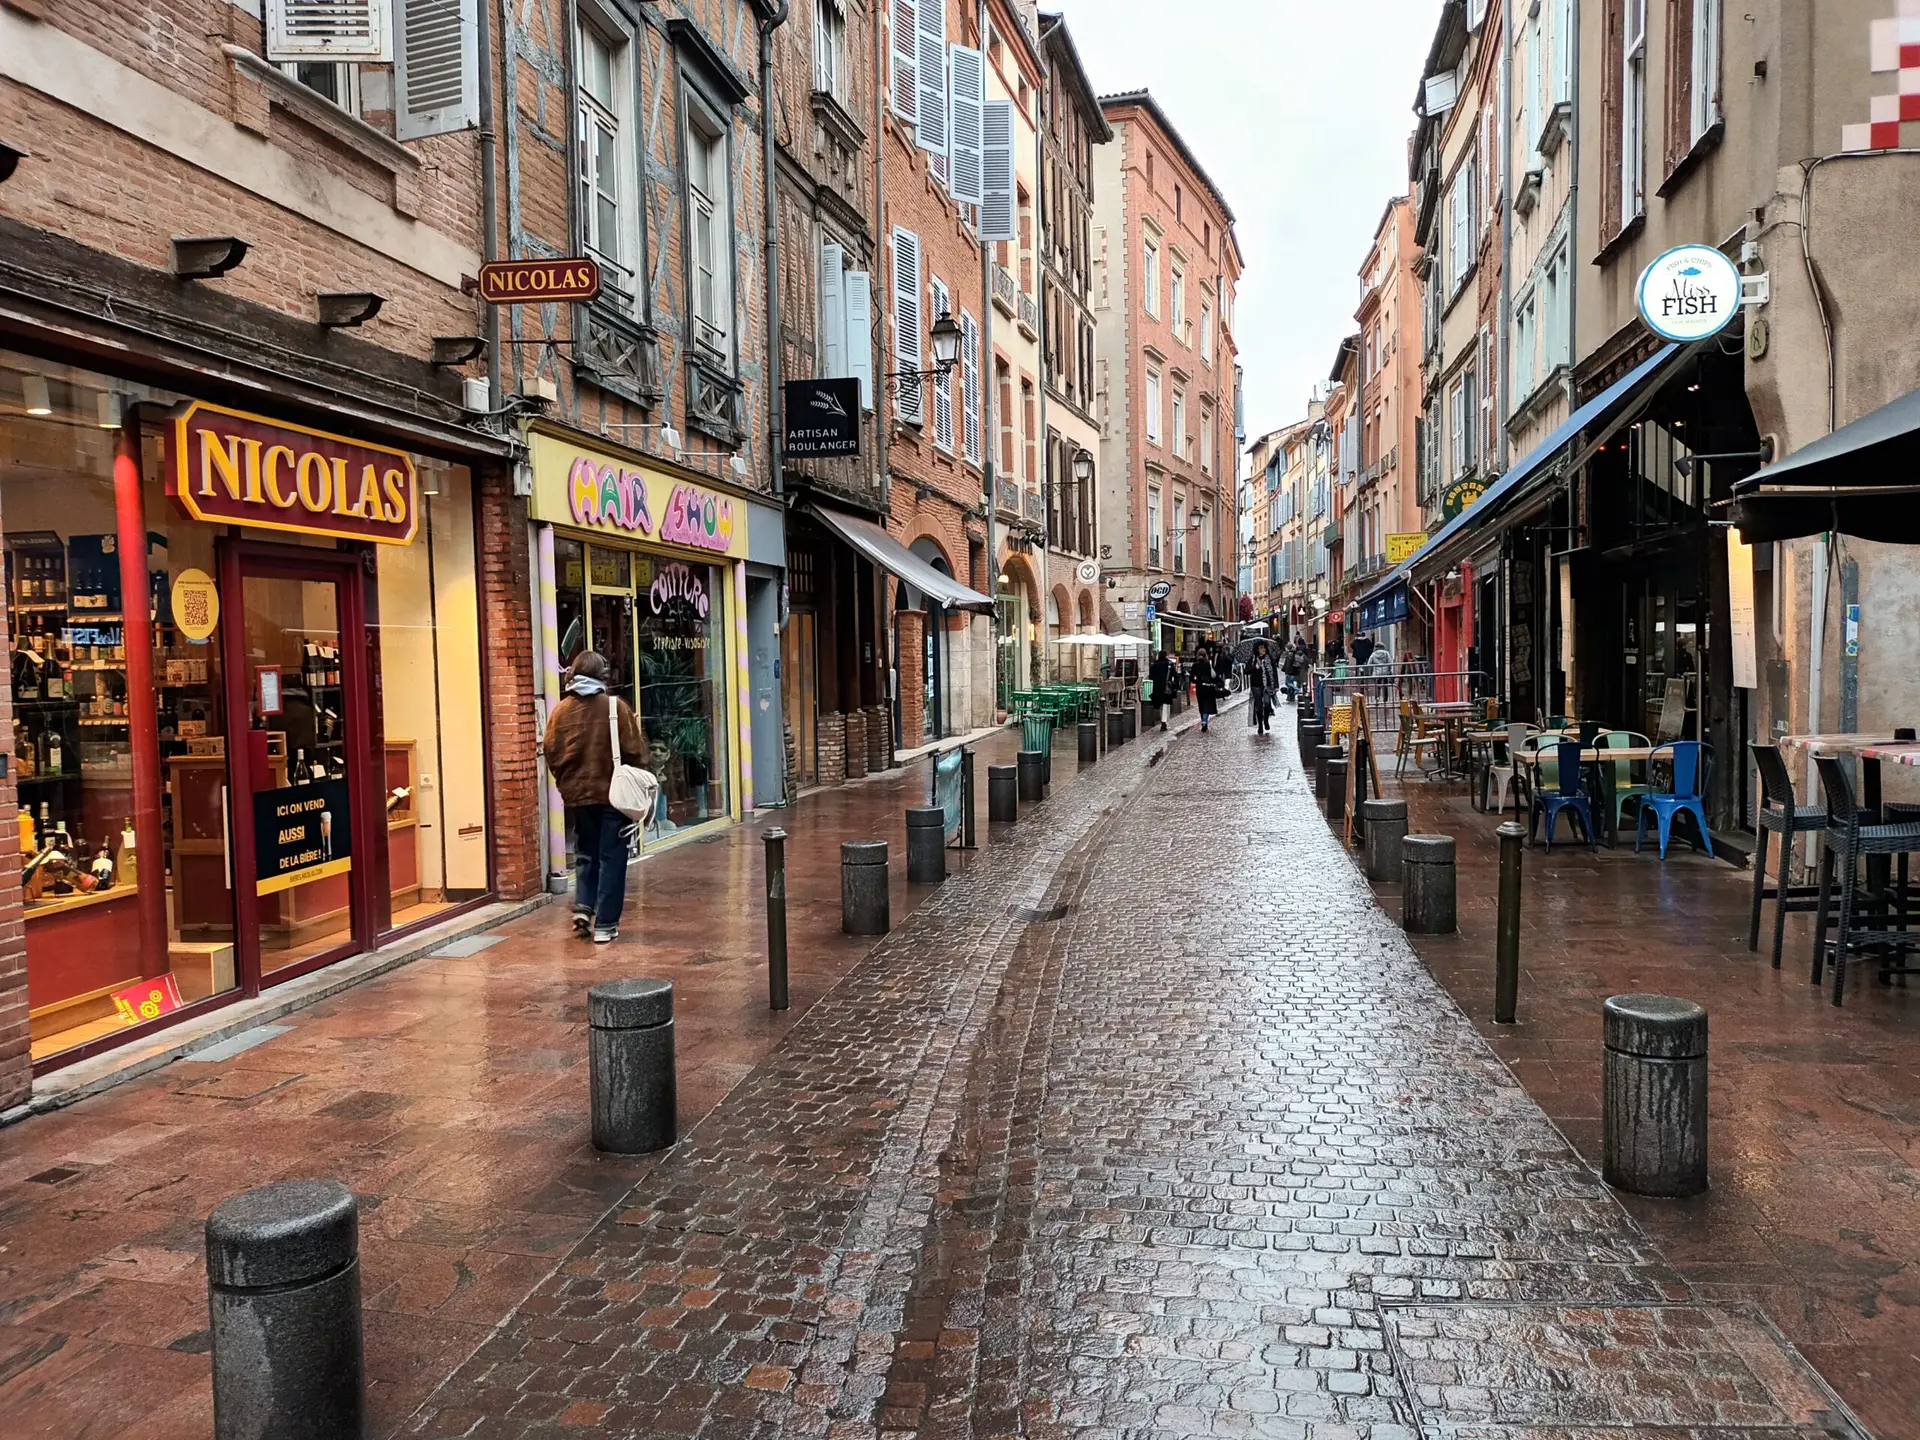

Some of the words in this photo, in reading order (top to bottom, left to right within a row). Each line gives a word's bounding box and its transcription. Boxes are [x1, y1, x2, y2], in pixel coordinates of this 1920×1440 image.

[488, 267, 590, 292] NICOLAS
[1664, 278, 1710, 299] Miss
[1661, 295, 1717, 316] FISH
[789, 428, 839, 439] ARTISAN
[788, 440, 857, 452] BOULANGER
[195, 428, 406, 524] NICOLAS
[572, 460, 651, 529] HAIR
[672, 488, 734, 541] SHOW
[1151, 587, 1168, 595] OCD
[277, 805, 289, 816] ICI
[290, 802, 303, 814] ON
[304, 798, 325, 811] VEND
[278, 825, 305, 844] AUSSI
[280, 858, 289, 868] DE
[290, 855, 299, 866] LA
[300, 849, 318, 864] BIÈRE
